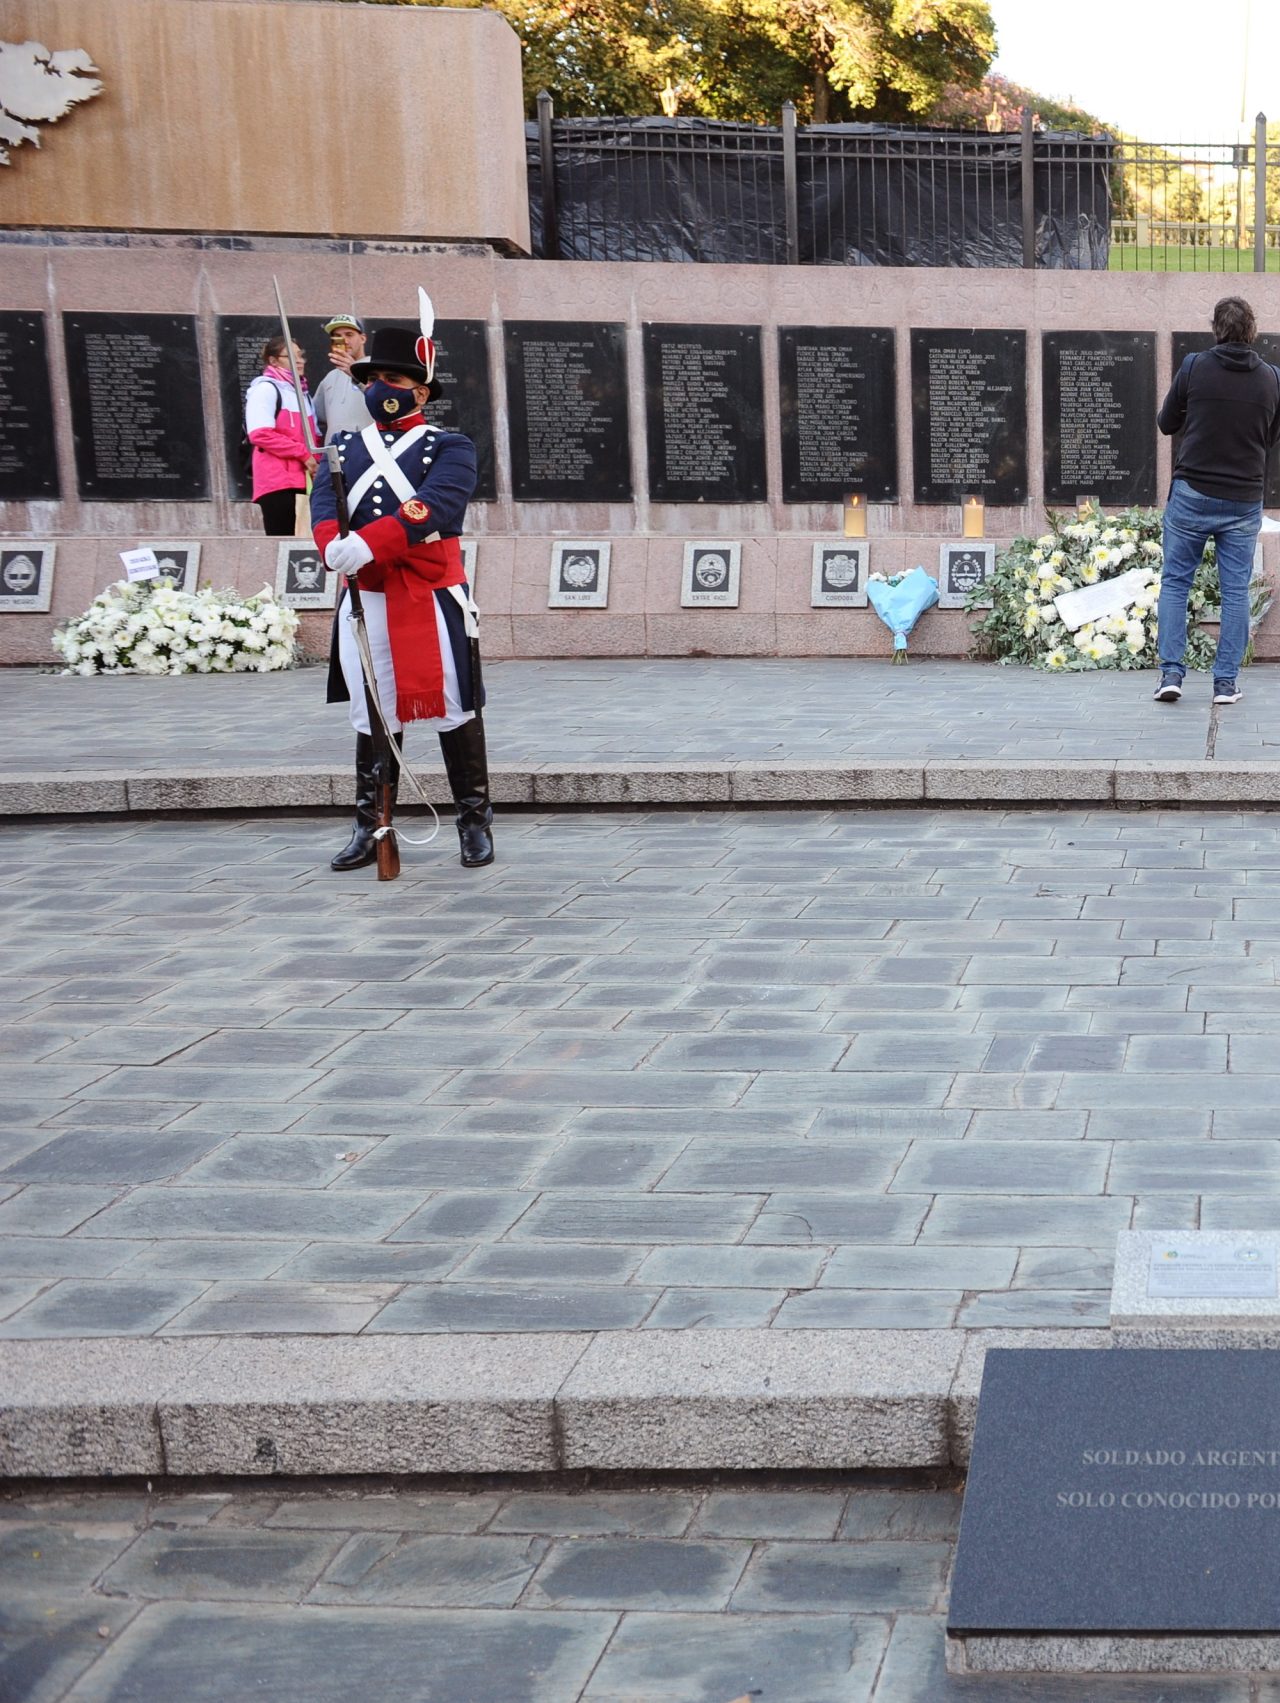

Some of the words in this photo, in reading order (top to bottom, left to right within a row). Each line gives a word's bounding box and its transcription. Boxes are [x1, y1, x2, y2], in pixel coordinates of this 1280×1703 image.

[1082, 1450, 1186, 1466] SOLDADO
[1056, 1492, 1115, 1508] SOLO
[1120, 1492, 1240, 1508] CONOCIDO
